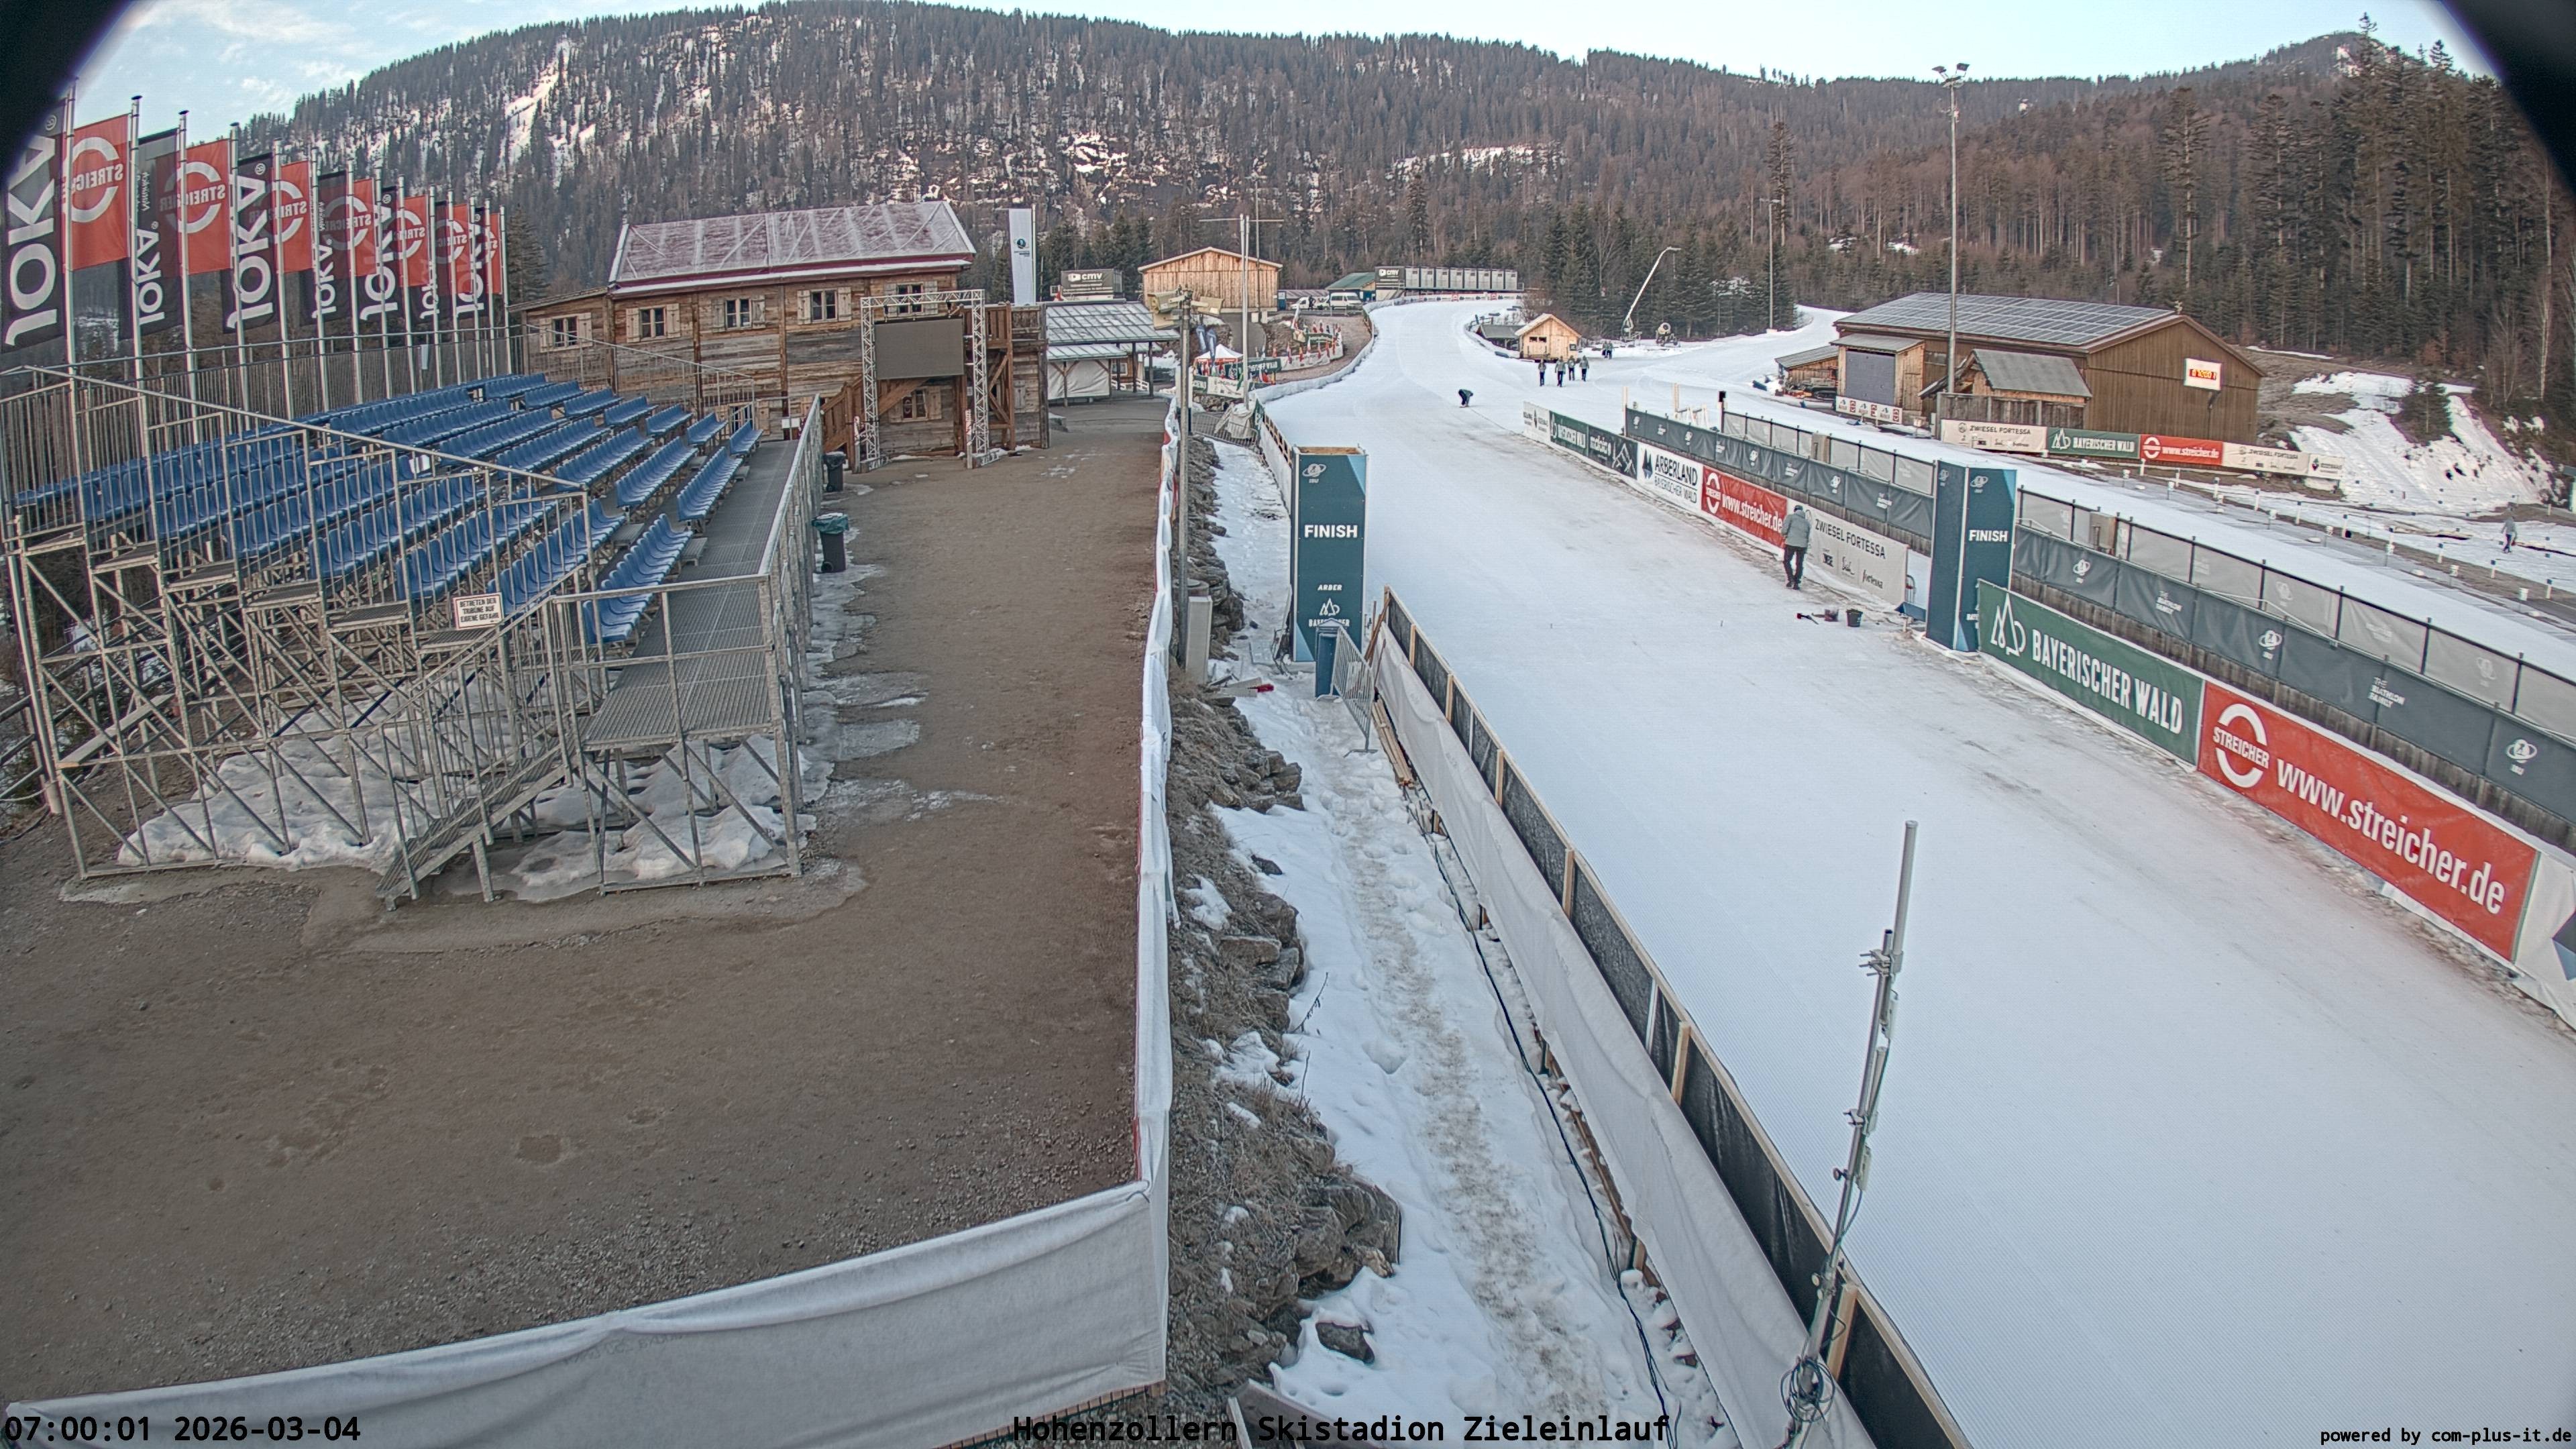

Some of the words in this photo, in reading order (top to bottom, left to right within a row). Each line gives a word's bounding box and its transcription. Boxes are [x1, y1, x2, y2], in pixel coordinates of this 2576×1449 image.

[1081, 272, 1103, 281] cmv
[2073, 437, 2116, 450] BAYERISCHER
[1655, 454, 1698, 486] ARBERLAND
[1684, 489, 1697, 504] WALD
[1722, 494, 1783, 532] www.streicher.de
[1304, 525, 1358, 538] FINISH
[1815, 519, 1845, 541] ZWIESEL
[1847, 532, 1886, 559] FORTESSA
[1968, 529, 2008, 542] FINISH
[2032, 629, 2131, 710] BAYERISCHER
[2134, 678, 2183, 735] WALD
[2212, 727, 2269, 770] STREICHER
[2277, 758, 2506, 915] www.streicher.de
